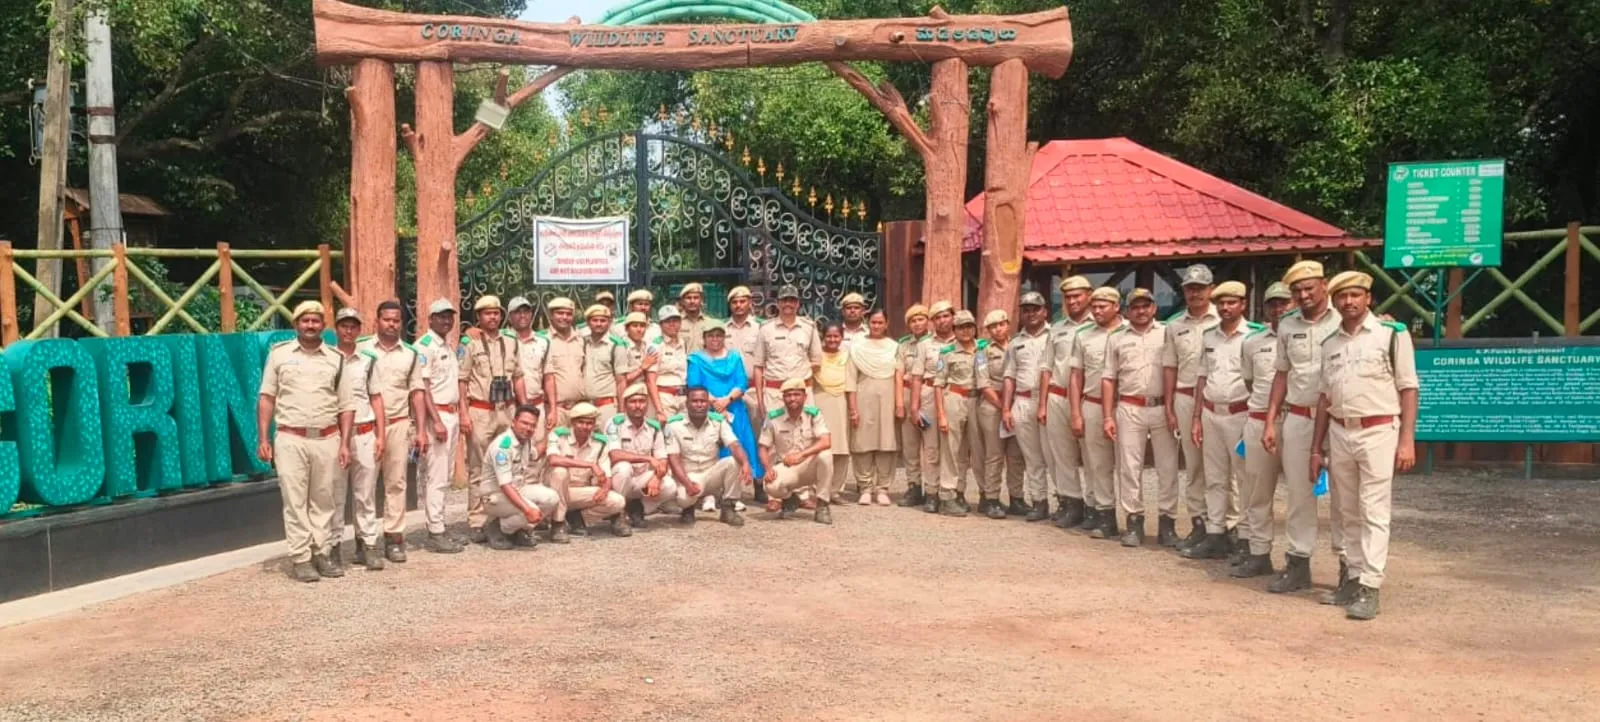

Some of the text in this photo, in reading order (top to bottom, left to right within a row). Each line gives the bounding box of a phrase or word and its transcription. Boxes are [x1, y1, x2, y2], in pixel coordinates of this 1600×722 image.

[421, 23, 800, 47] CORINGA WILDLIFE SANCTUARY
[1412, 168, 1439, 179] TICKET
[1440, 166, 1477, 177] COUNTER
[1433, 354, 1600, 366] CORINGA WILDLIFE SANCTUARY
